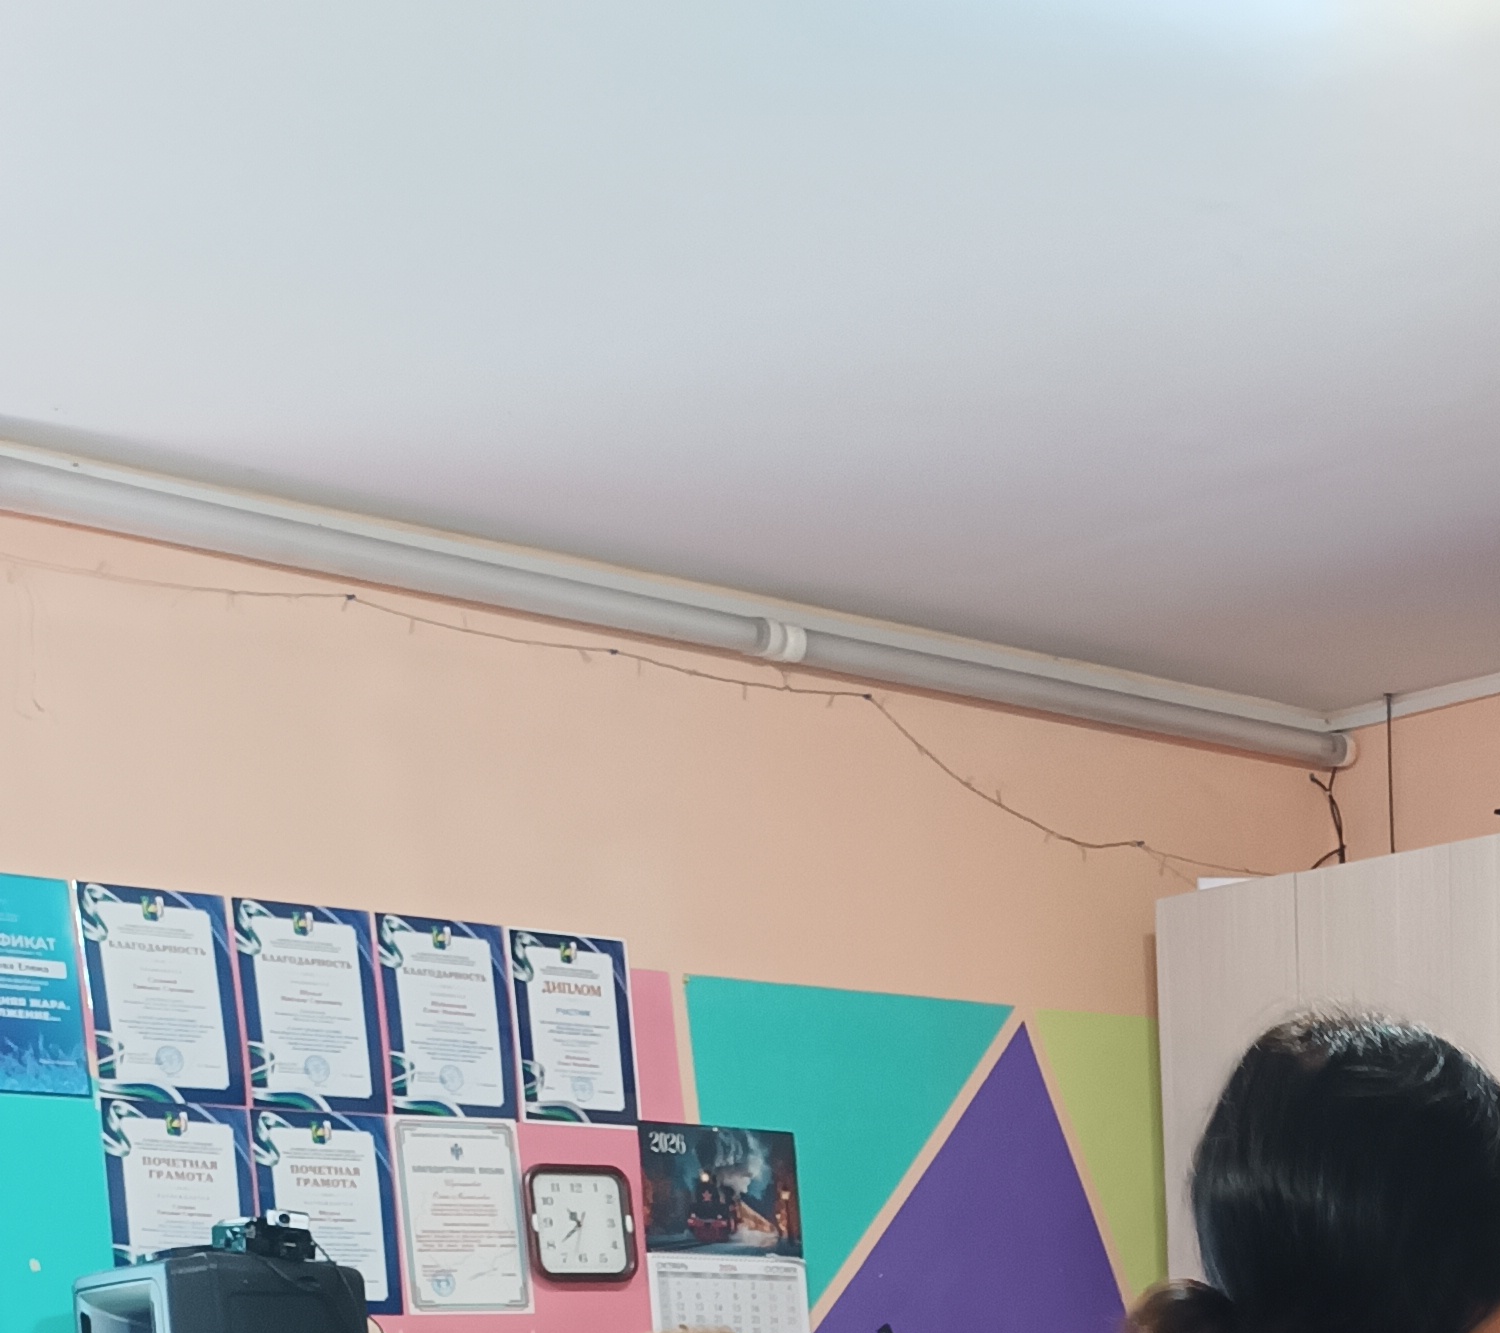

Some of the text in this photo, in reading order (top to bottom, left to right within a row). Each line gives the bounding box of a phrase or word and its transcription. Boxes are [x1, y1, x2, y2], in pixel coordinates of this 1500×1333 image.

[542, 981, 601, 997] ДИПЛОМ
[649, 1131, 687, 1154] 2026
[142, 1156, 218, 1170] ПОЧЕТНАЯ
[148, 1169, 214, 1183] ГРАМОТА
[290, 1164, 360, 1177] ПОЧЕТНАЯ
[296, 1176, 357, 1189] ГРАМОТА
[570, 1183, 583, 1193] 12
[542, 1197, 554, 1206] 10
[560, 1253, 569, 1263] 7
[578, 1253, 588, 1263] 6
[599, 1253, 608, 1263] 5
